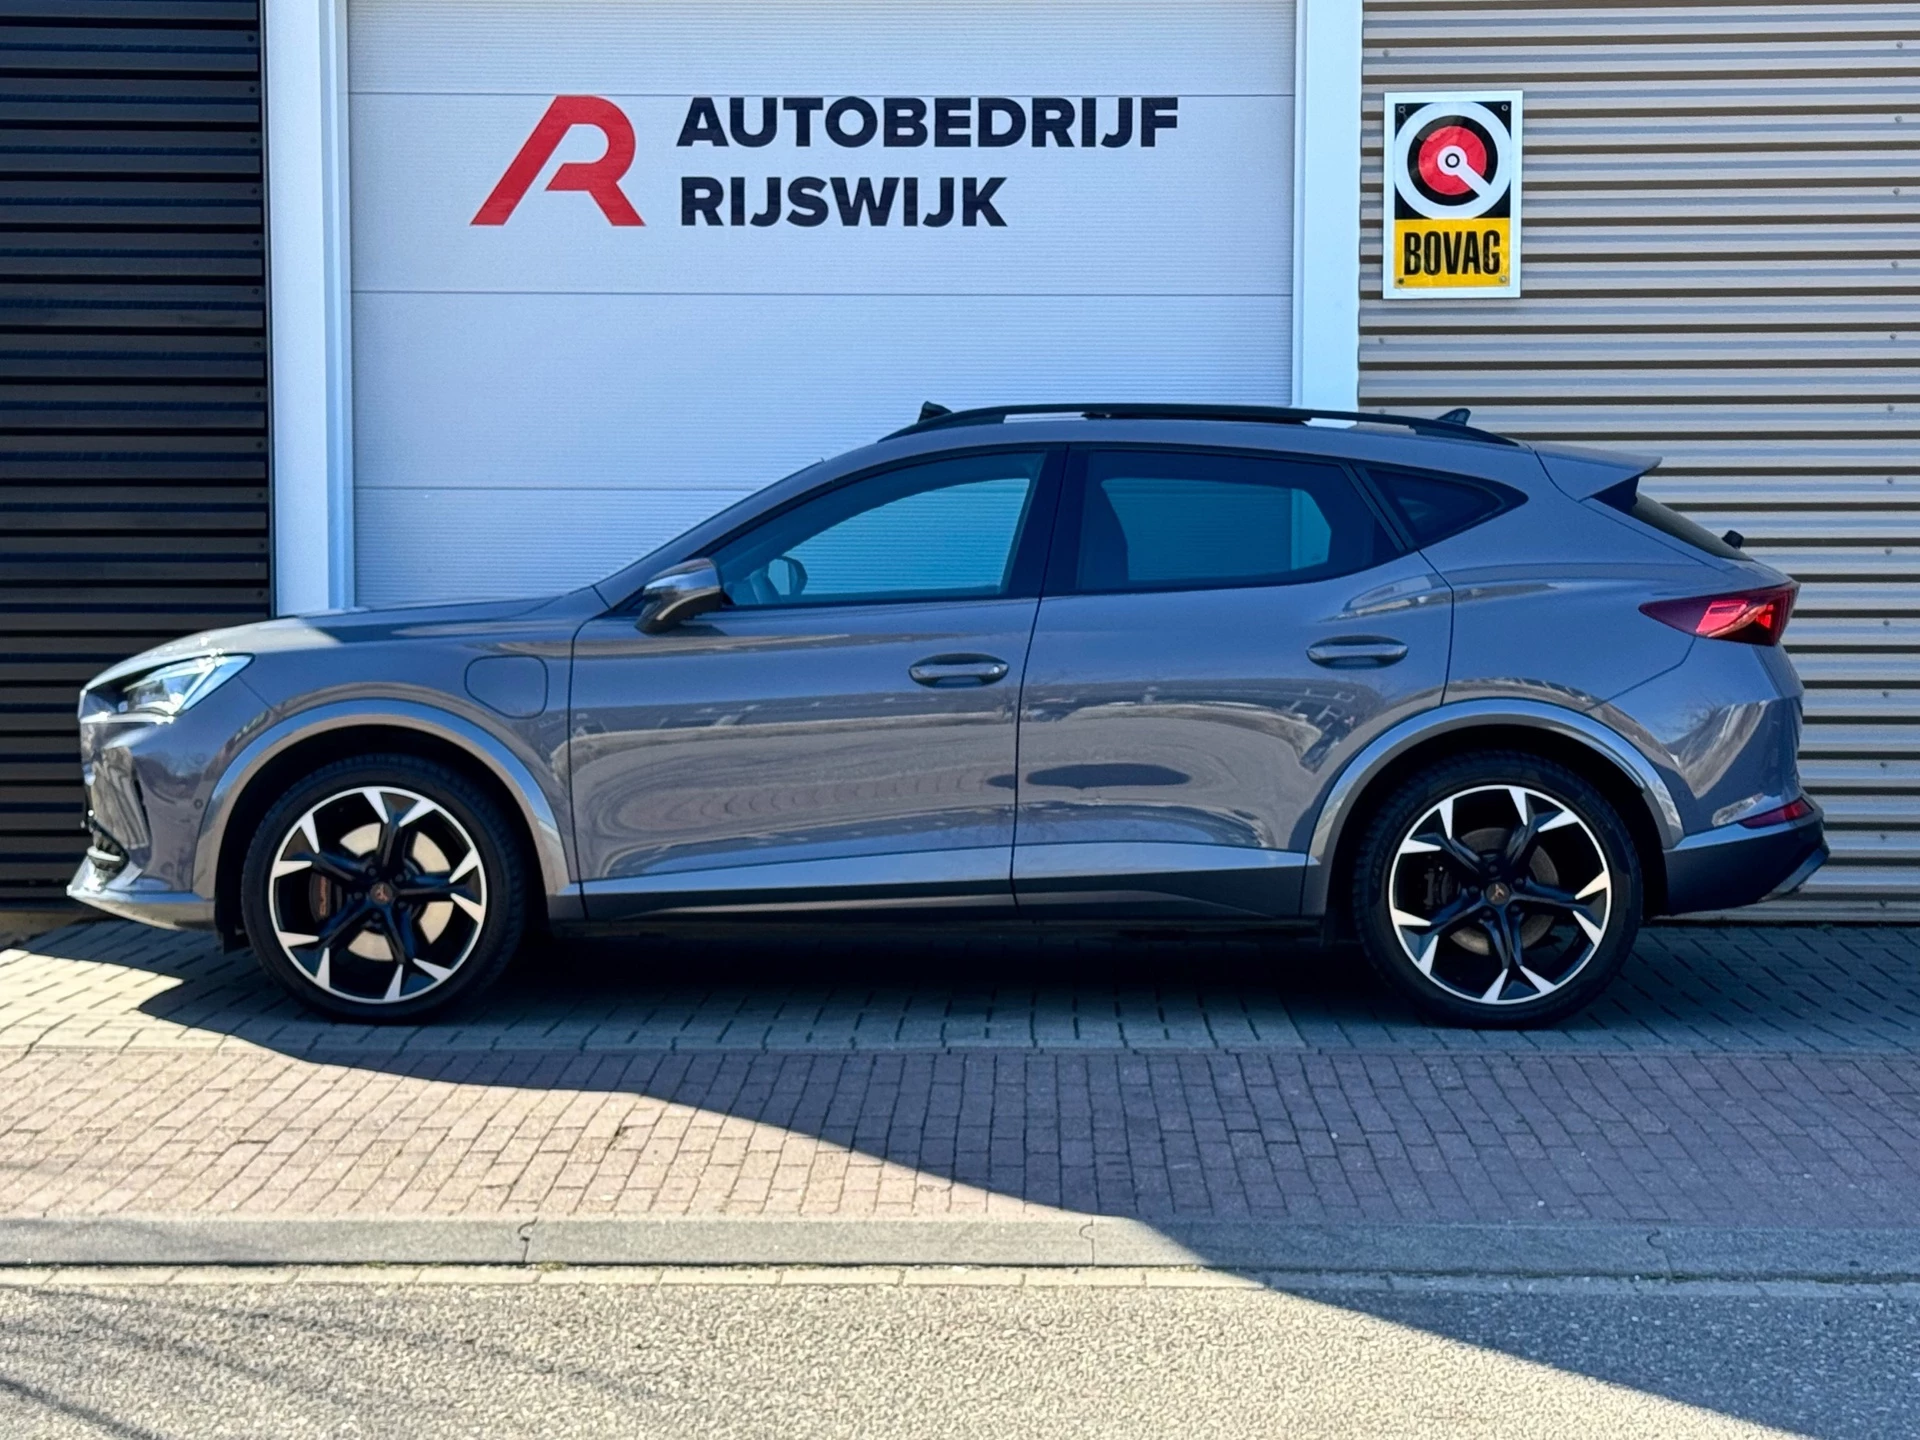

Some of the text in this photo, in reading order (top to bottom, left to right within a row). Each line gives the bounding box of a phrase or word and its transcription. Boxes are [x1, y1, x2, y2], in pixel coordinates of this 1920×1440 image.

[677, 96, 1178, 148] AUTOBEDRIJF
[681, 177, 1007, 227] RIJSWIJK
[1403, 230, 1501, 275] BOVAG
